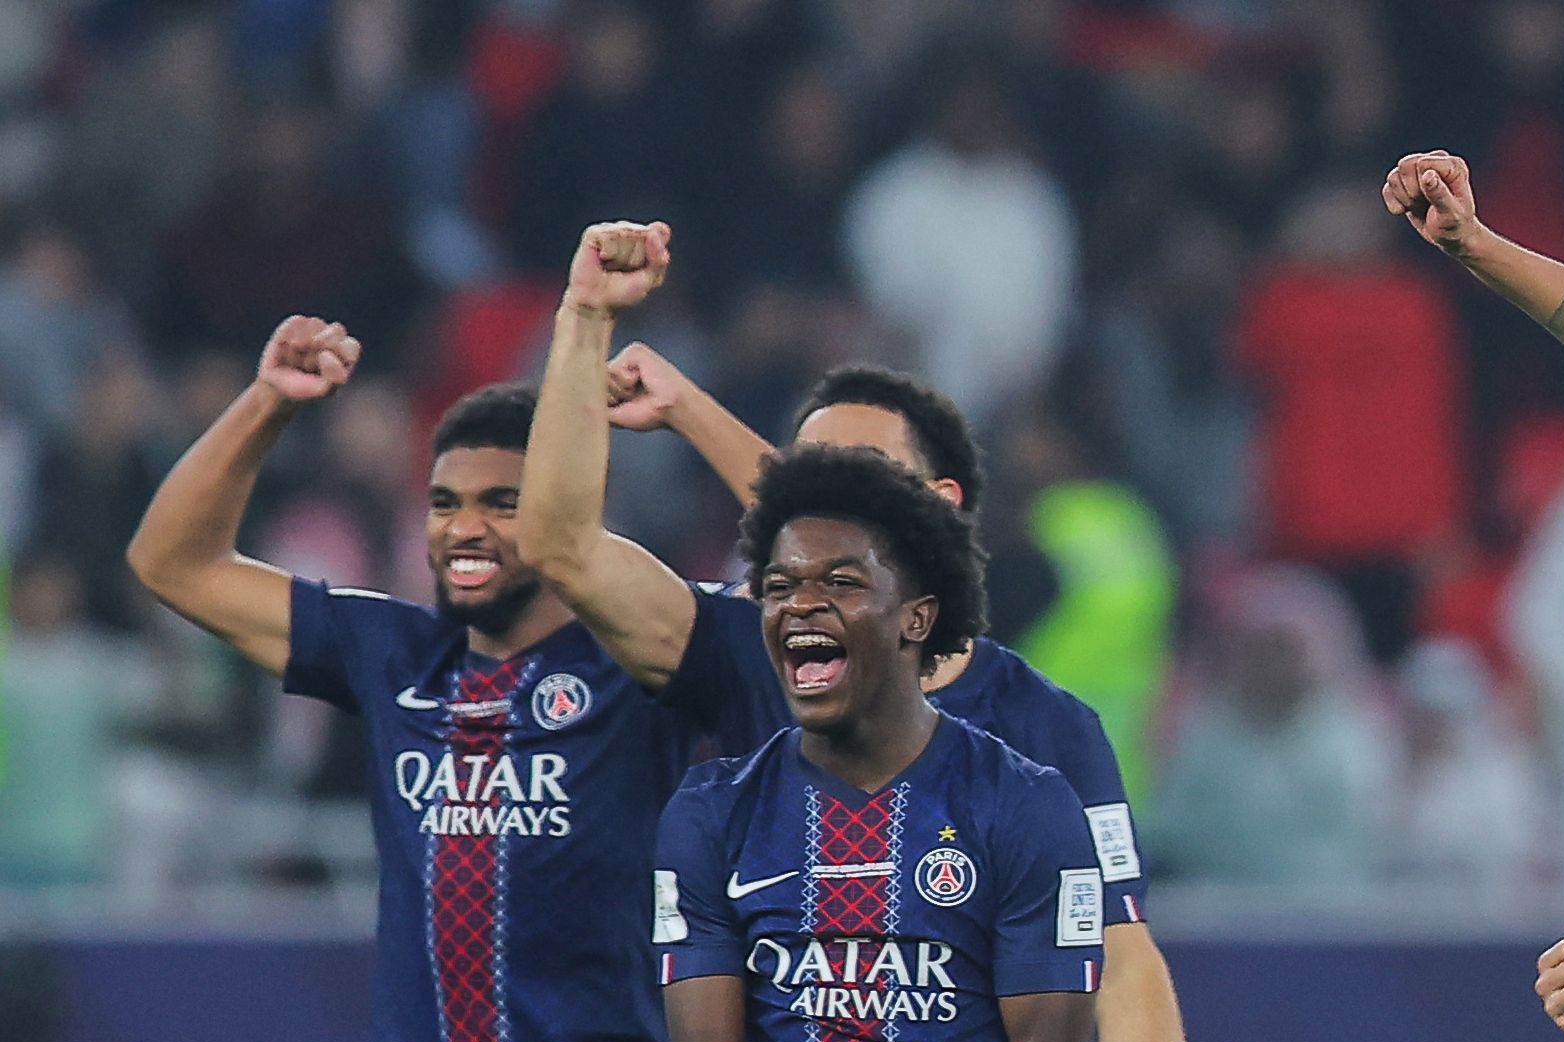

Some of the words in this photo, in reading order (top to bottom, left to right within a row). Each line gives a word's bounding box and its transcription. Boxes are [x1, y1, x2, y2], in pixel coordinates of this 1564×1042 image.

[395, 750, 571, 811] QATAR
[419, 806, 571, 837] AIRWAYS
[925, 852, 965, 867] PARIS
[747, 938, 957, 993] QATAR
[790, 987, 957, 1022] AIRWAYS
